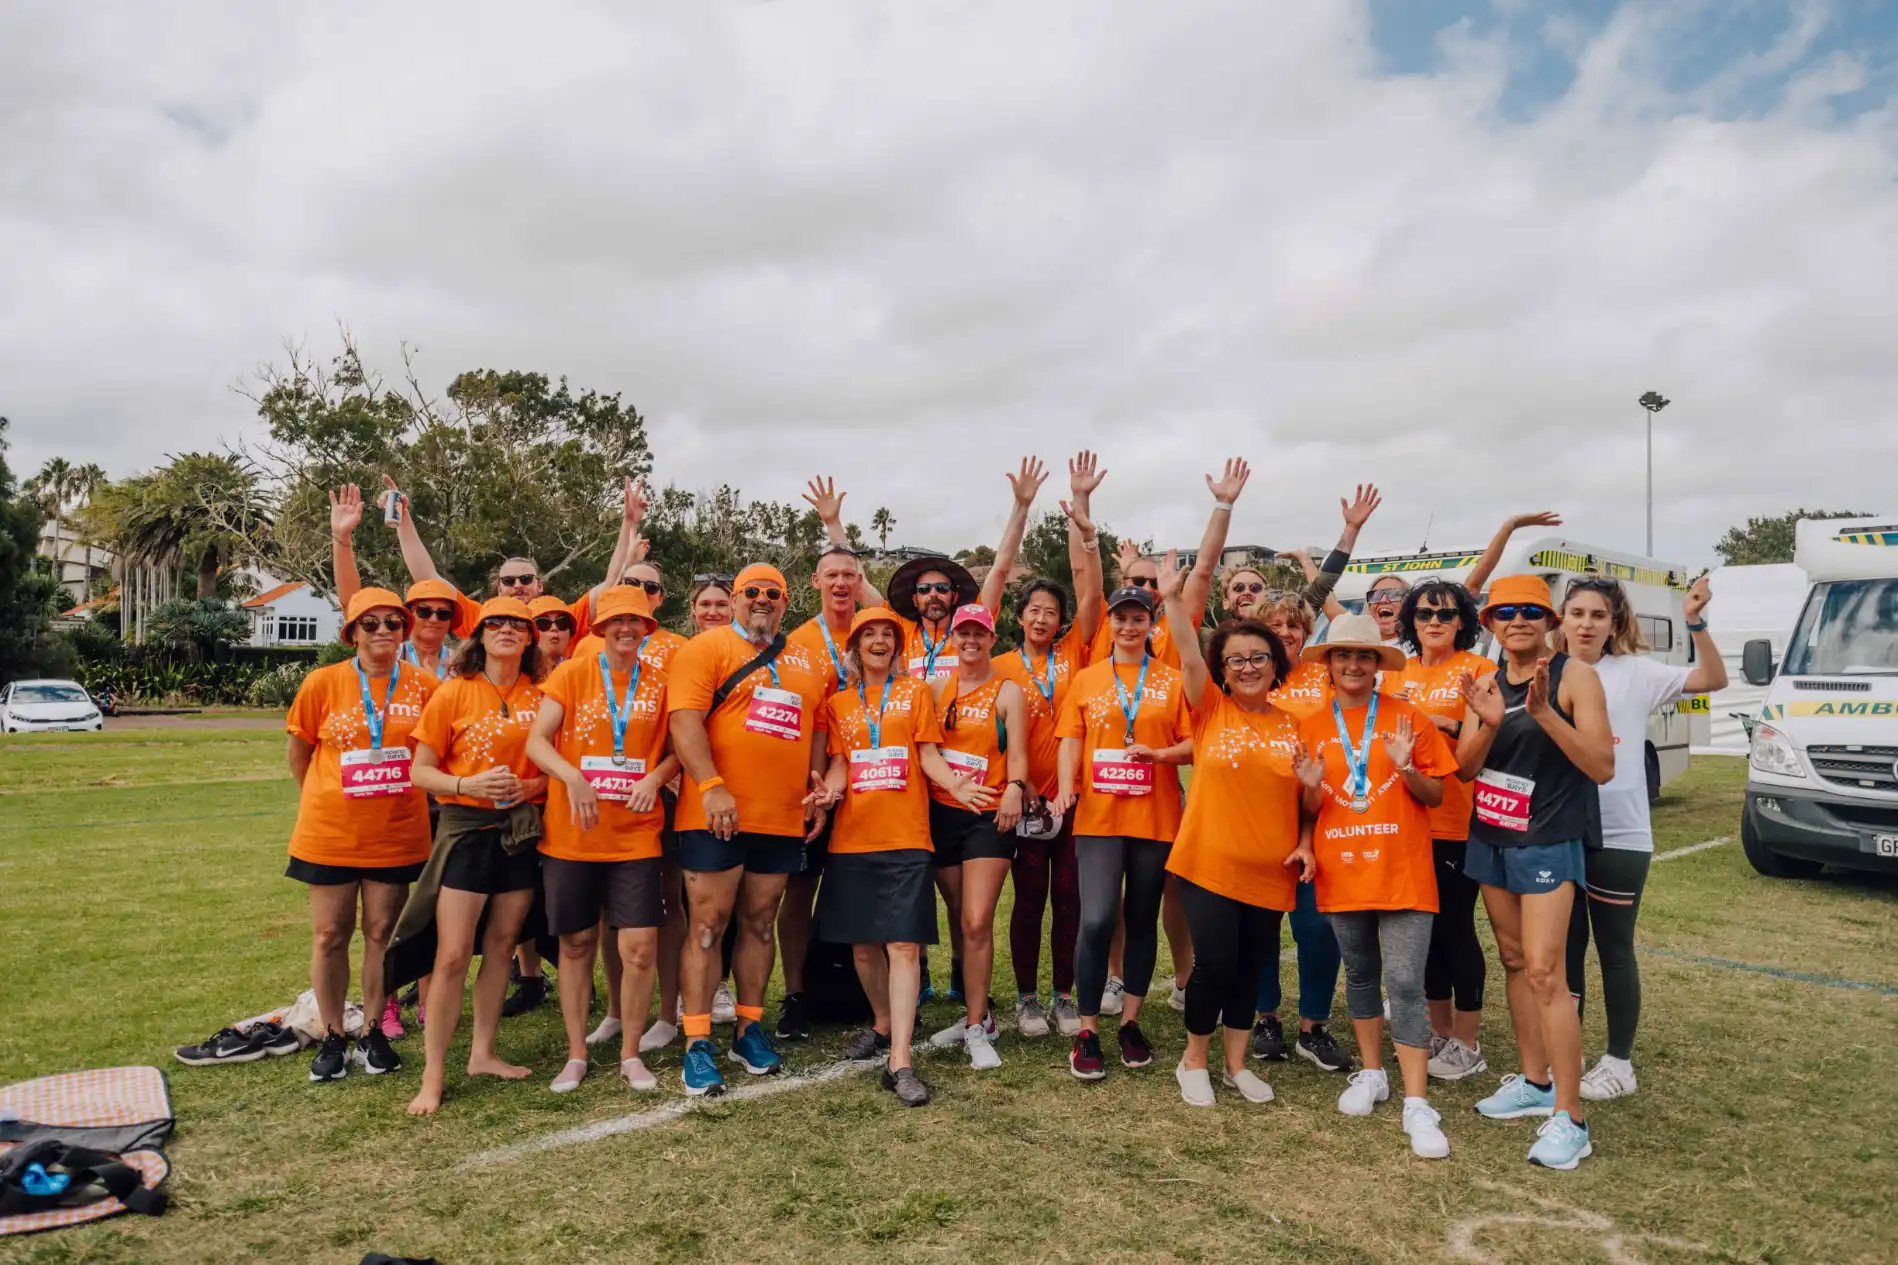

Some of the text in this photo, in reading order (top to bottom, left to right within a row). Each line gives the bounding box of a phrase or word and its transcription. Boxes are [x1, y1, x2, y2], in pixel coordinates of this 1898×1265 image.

[1381, 560, 1443, 572] ST JOHN
[1290, 687, 1322, 698] ms
[1429, 687, 1458, 700] ms
[389, 703, 421, 717] ms
[883, 700, 911, 712] ms
[962, 705, 990, 719] ms
[1814, 702, 1898, 715] AMB
[756, 705, 799, 725] 42274
[352, 766, 402, 783] 44716
[859, 765, 901, 780] 40615
[1098, 767, 1145, 781] 42266
[1477, 790, 1519, 812] 44717
[1325, 823, 1399, 840] VOLUNTEER
